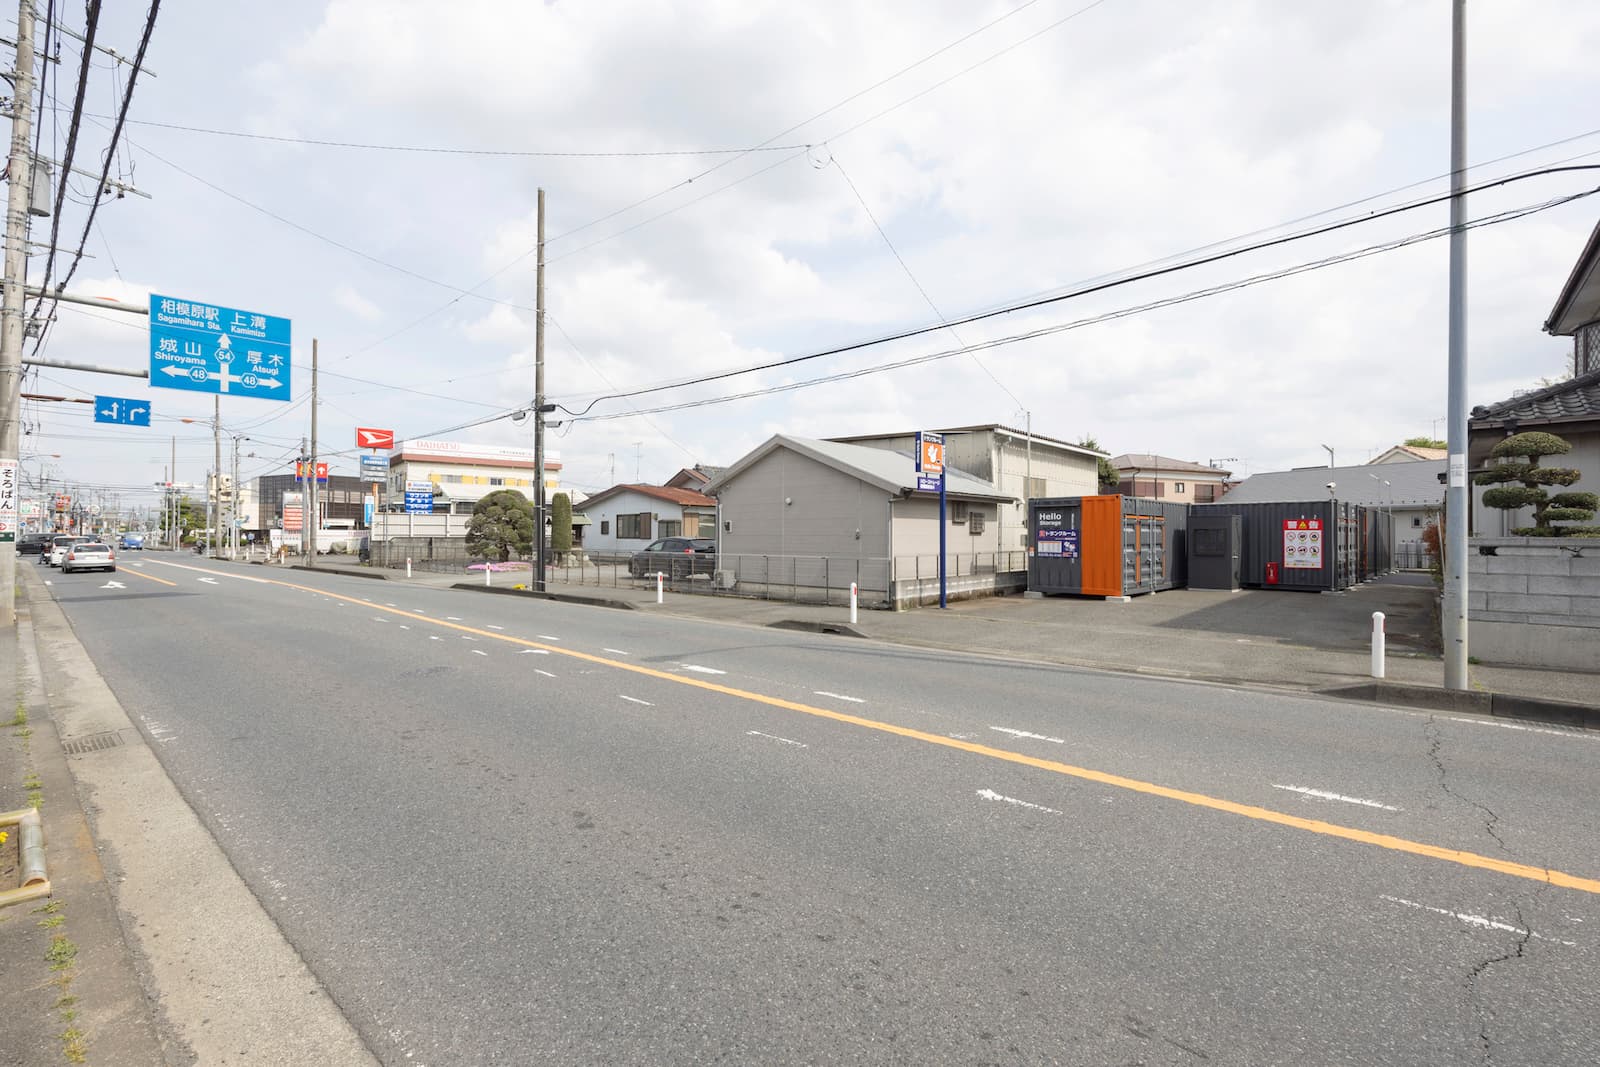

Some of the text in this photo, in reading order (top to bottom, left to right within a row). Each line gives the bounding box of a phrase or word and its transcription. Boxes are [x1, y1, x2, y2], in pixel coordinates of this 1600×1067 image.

[161, 299, 219, 321] 相模原駅
[157, 313, 222, 331] Sagamihara Sta.
[231, 312, 266, 329] 上溝
[231, 326, 266, 338] Kamimizo
[159, 338, 202, 356] 城山
[154, 351, 207, 365] Shiroyama
[218, 350, 231, 359] 54
[247, 351, 284, 366] 厚木
[191, 369, 205, 379] 48
[252, 365, 279, 375] Atsugi
[243, 376, 256, 385] 48
[1, 468, 14, 510] そろばん
[1040, 512, 1062, 521] Hello
